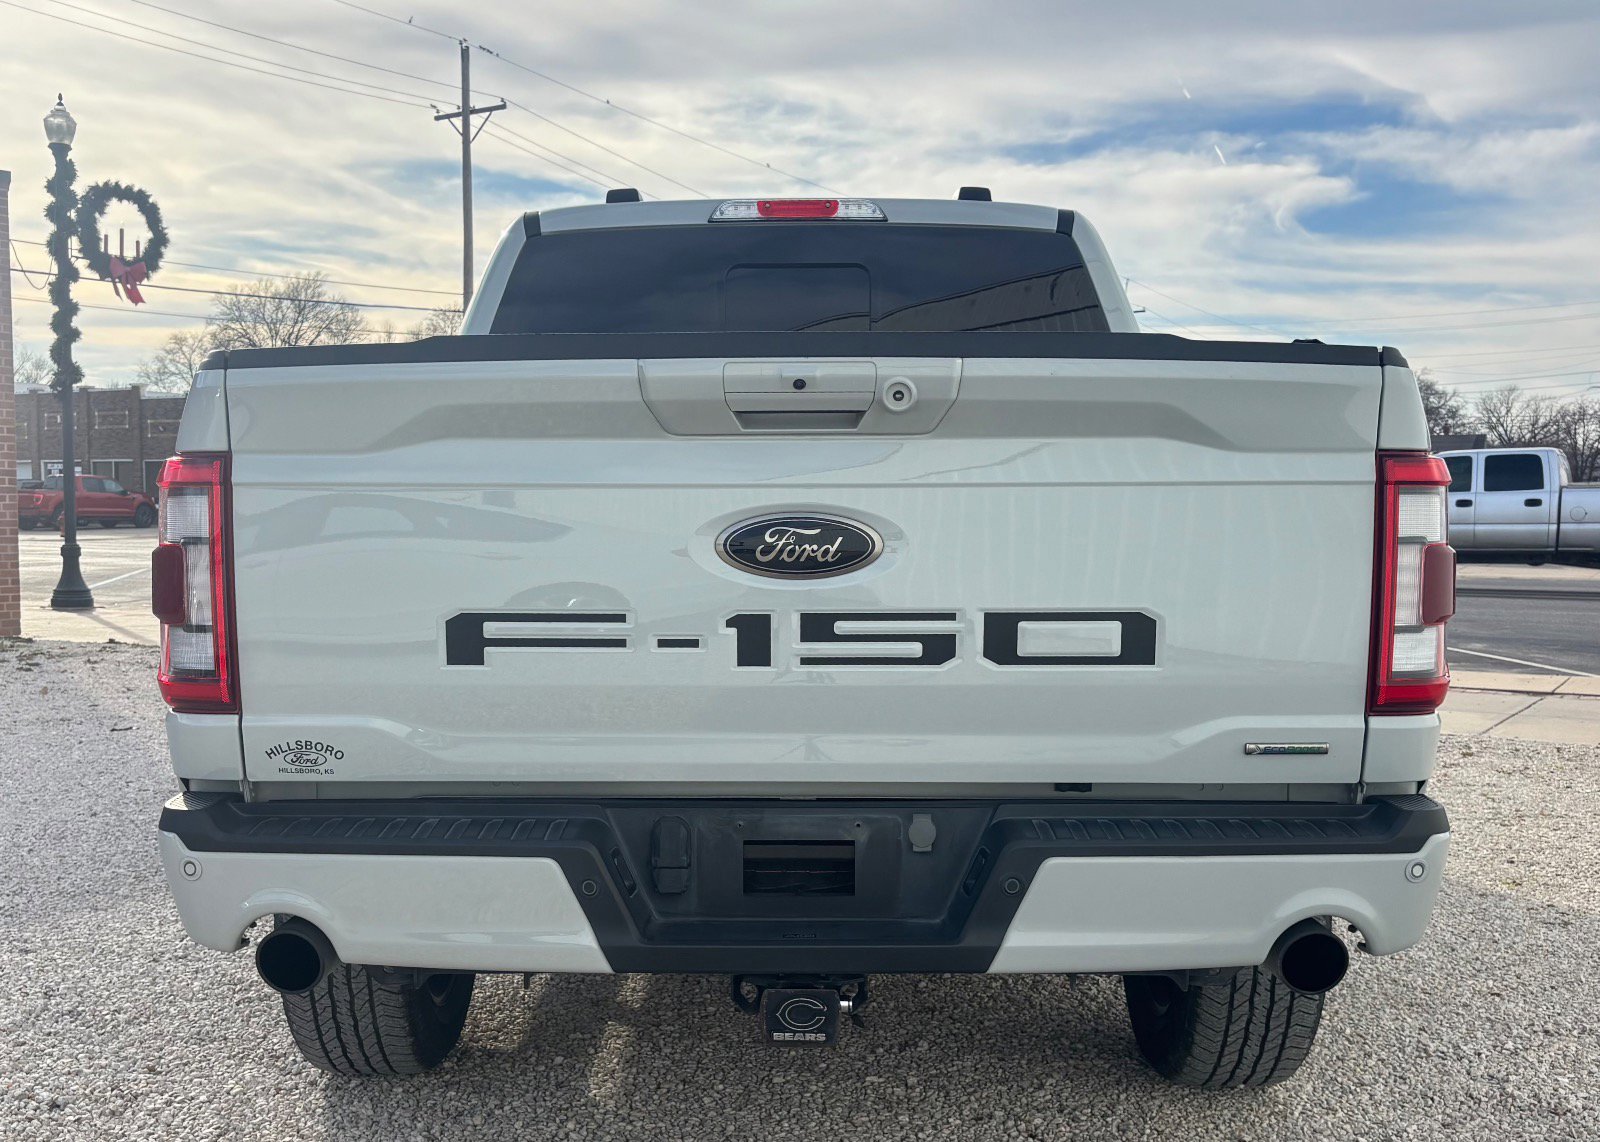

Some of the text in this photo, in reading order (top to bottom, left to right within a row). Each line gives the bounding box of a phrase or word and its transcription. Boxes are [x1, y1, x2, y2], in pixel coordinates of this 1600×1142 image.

[755, 526, 844, 563] Ford
[443, 610, 1158, 667] F-150
[265, 740, 345, 760] HILLSBORO
[290, 752, 320, 765] Ford
[278, 767, 323, 775] HILLSBORO,
[773, 1032, 826, 1041] BEARS
